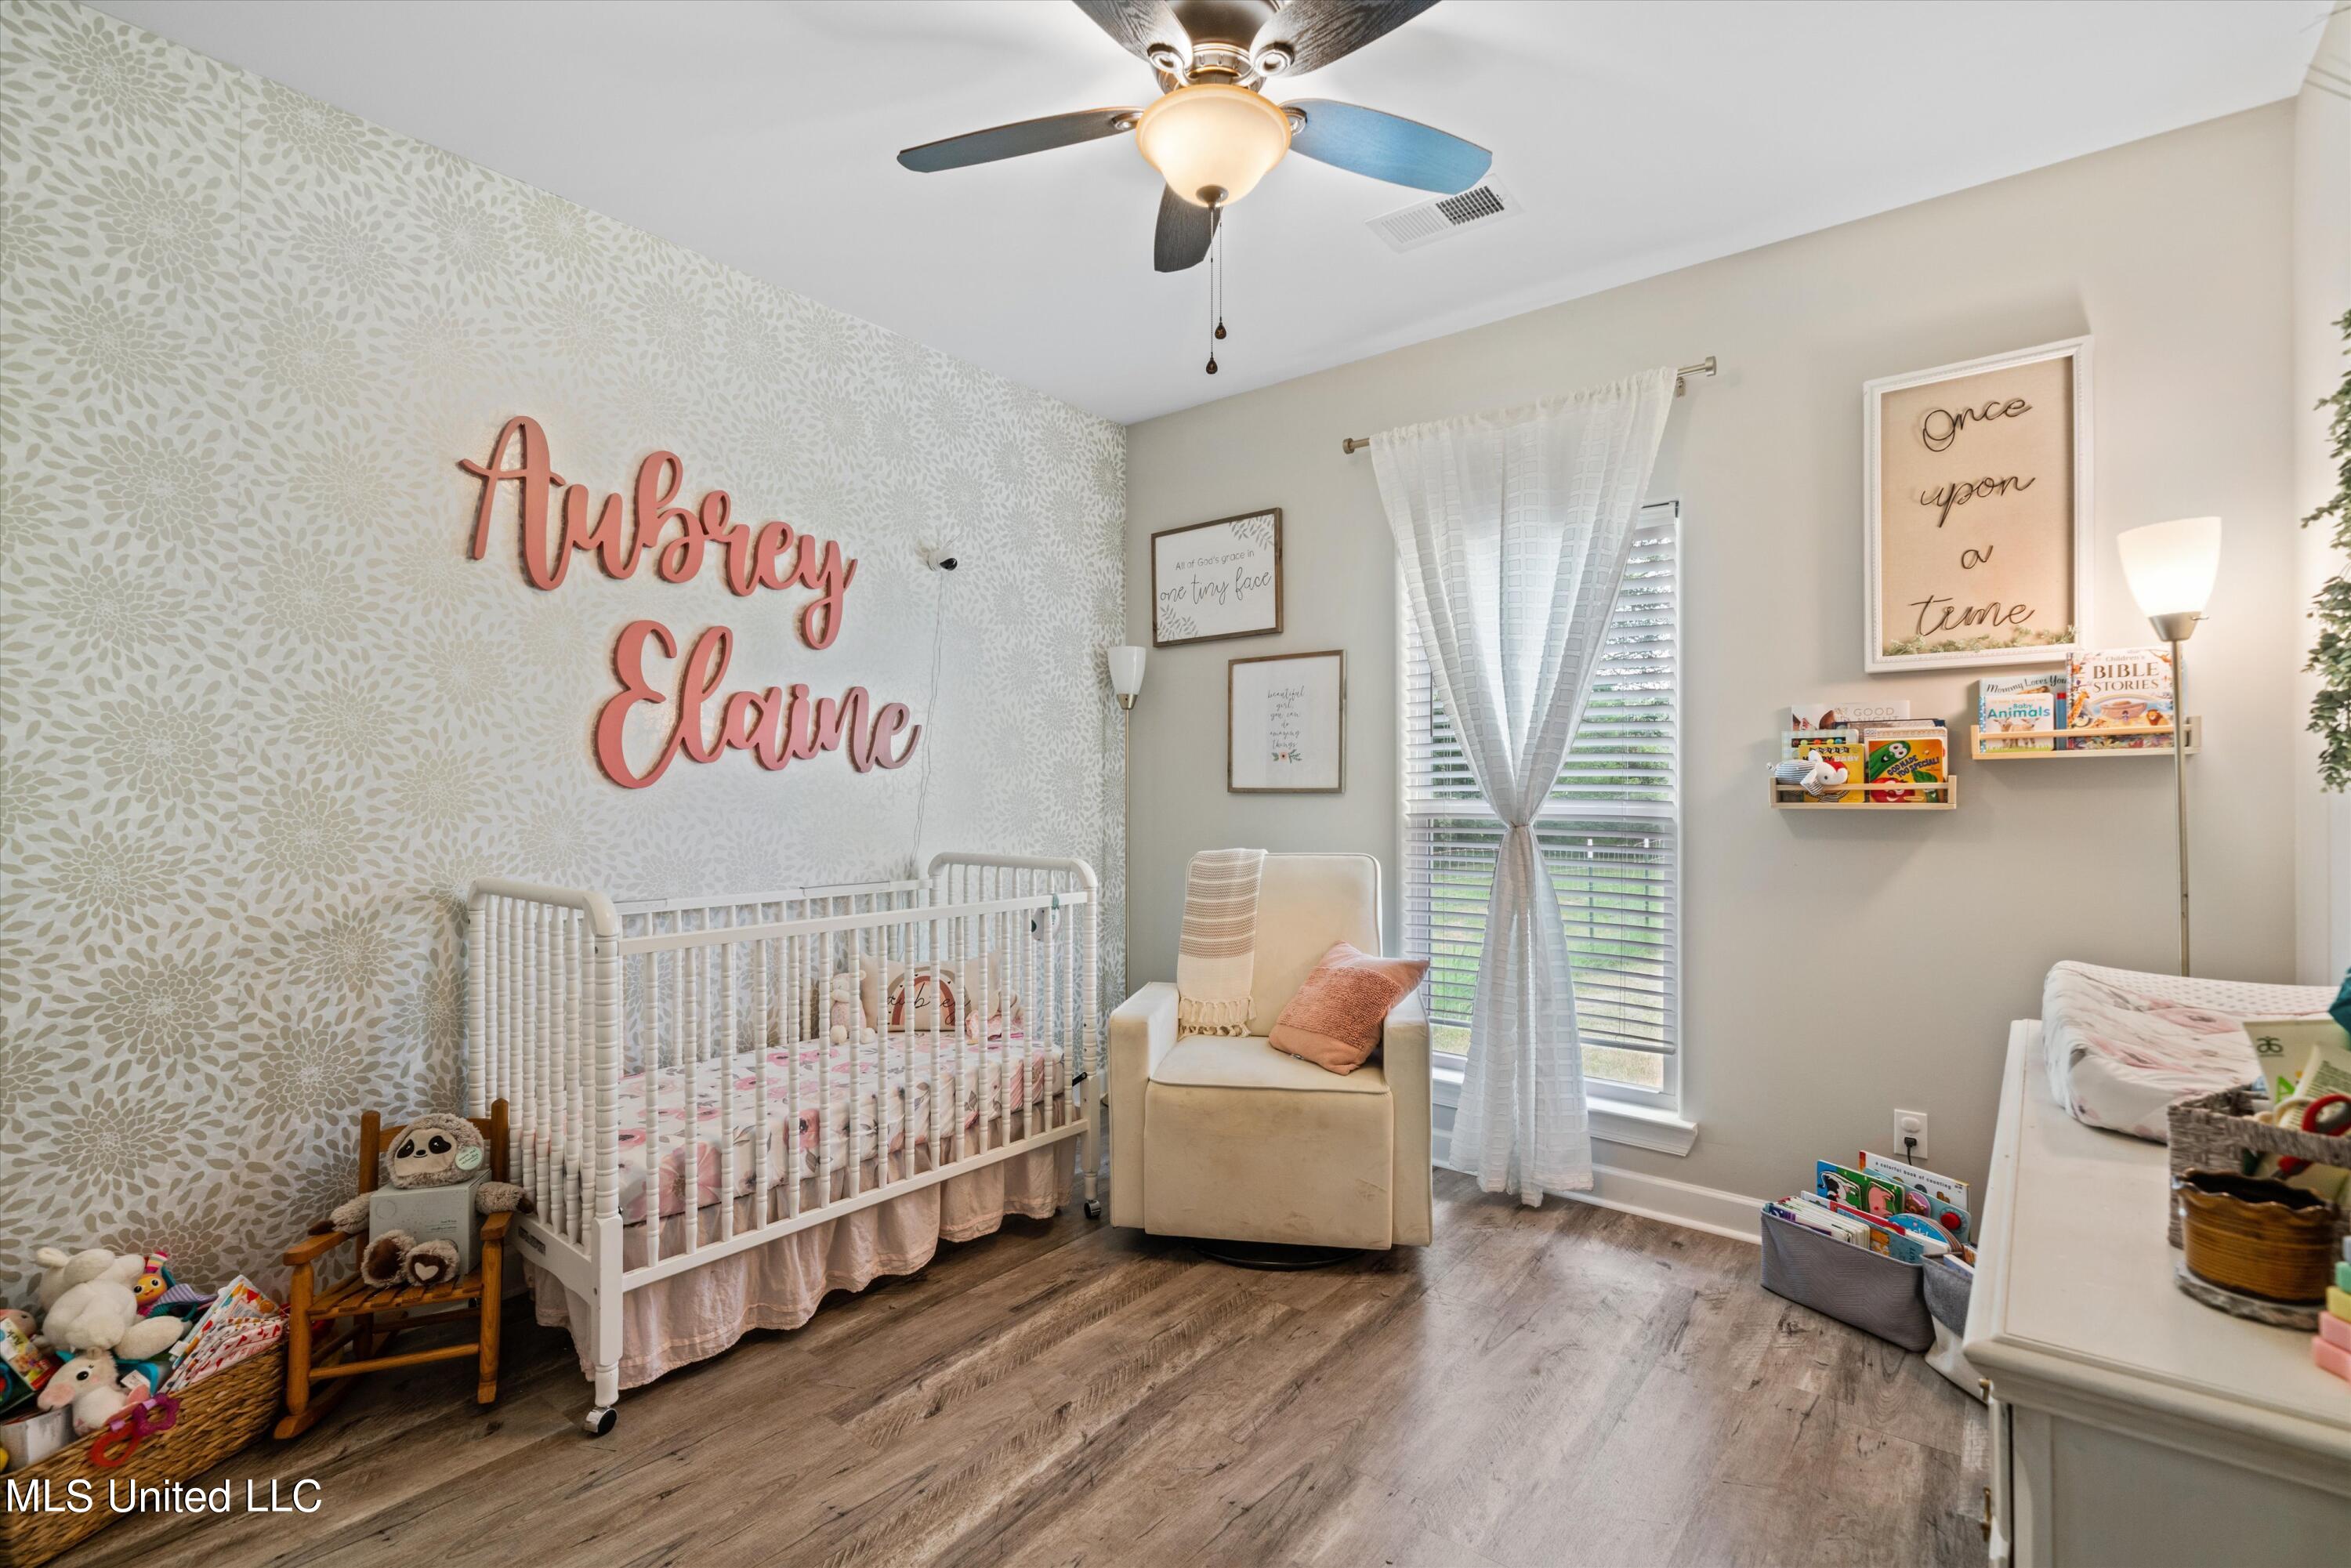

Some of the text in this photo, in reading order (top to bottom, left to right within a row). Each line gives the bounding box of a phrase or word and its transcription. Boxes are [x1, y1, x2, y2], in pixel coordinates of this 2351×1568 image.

[1922, 398, 2033, 452] Once
[1919, 476, 2036, 528] upon
[457, 415, 858, 650] Aubrey
[1176, 549, 1255, 571] All of God's grace in
[1961, 545, 1994, 570] a
[1159, 566, 1273, 606] one tiny face
[1907, 594, 2036, 637] time
[2093, 661, 2160, 679] BIBLE
[1267, 685, 1305, 701] beautiful
[1986, 683, 2024, 693] Mommy
[2024, 677, 2048, 688] Loves
[2093, 679, 2159, 693] STORIES
[596, 619, 922, 789] Elaine
[1853, 707, 1895, 717] GOOD
[1987, 705, 2051, 719] Animals
[1887, 755, 1918, 776] GOD MADE
[1896, 766, 1910, 777] YOU
[1910, 757, 1940, 772] SPECIAL!
[1904, 1170, 1917, 1179] book
